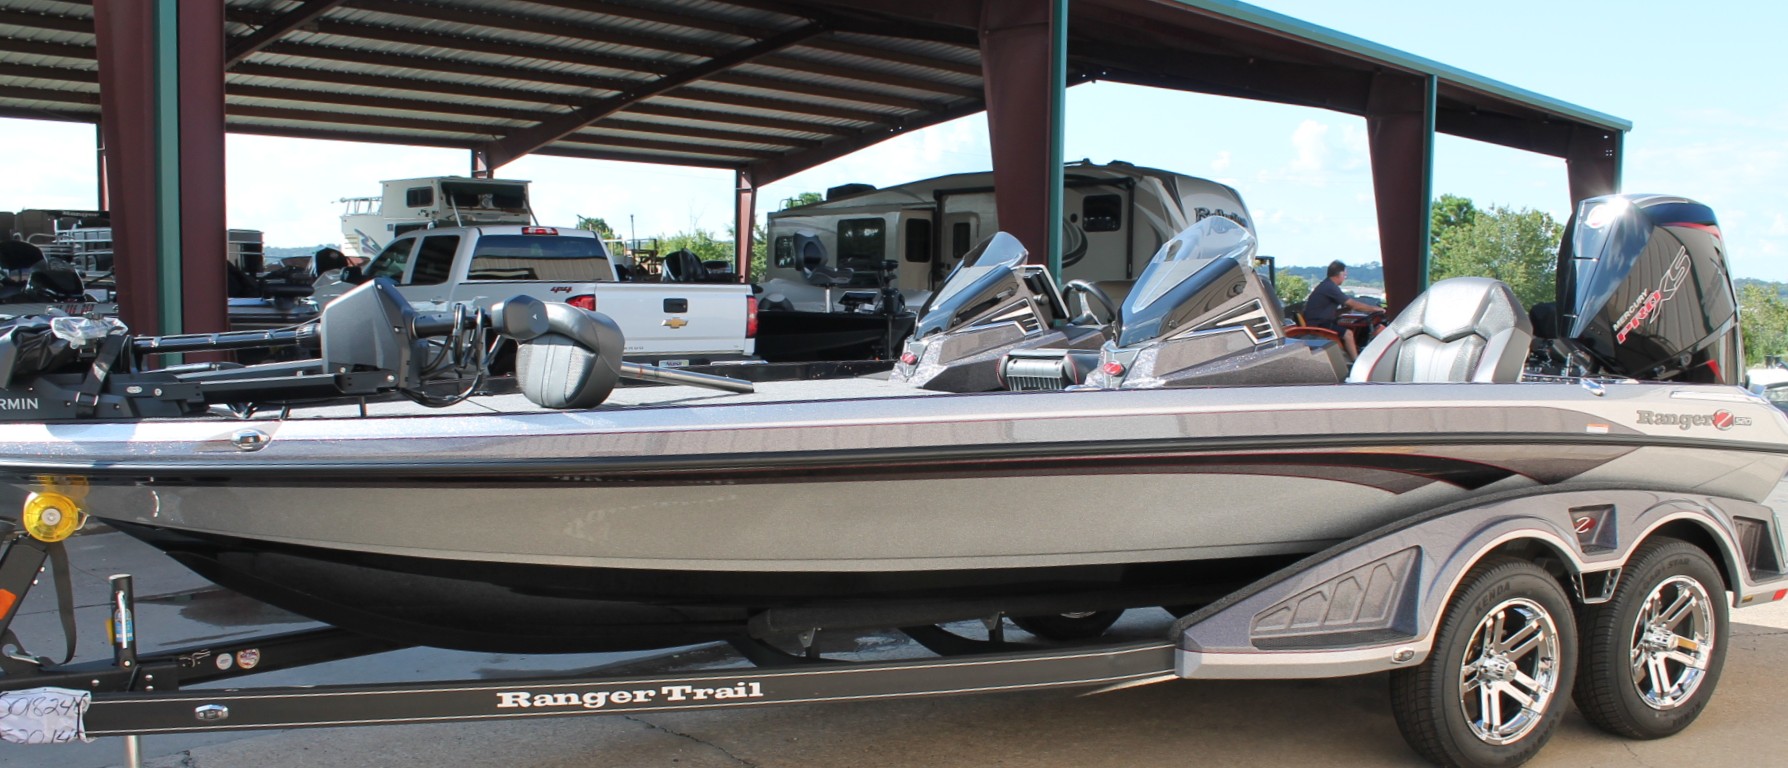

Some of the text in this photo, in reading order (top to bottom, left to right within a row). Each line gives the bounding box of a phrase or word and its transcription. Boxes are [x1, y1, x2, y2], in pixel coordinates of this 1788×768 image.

[1613, 288, 1648, 331] MERCURY
[1636, 409, 1714, 431] Ranger
[1474, 581, 1511, 615] KENDA
[496, 682, 764, 709] Ranger Trail
